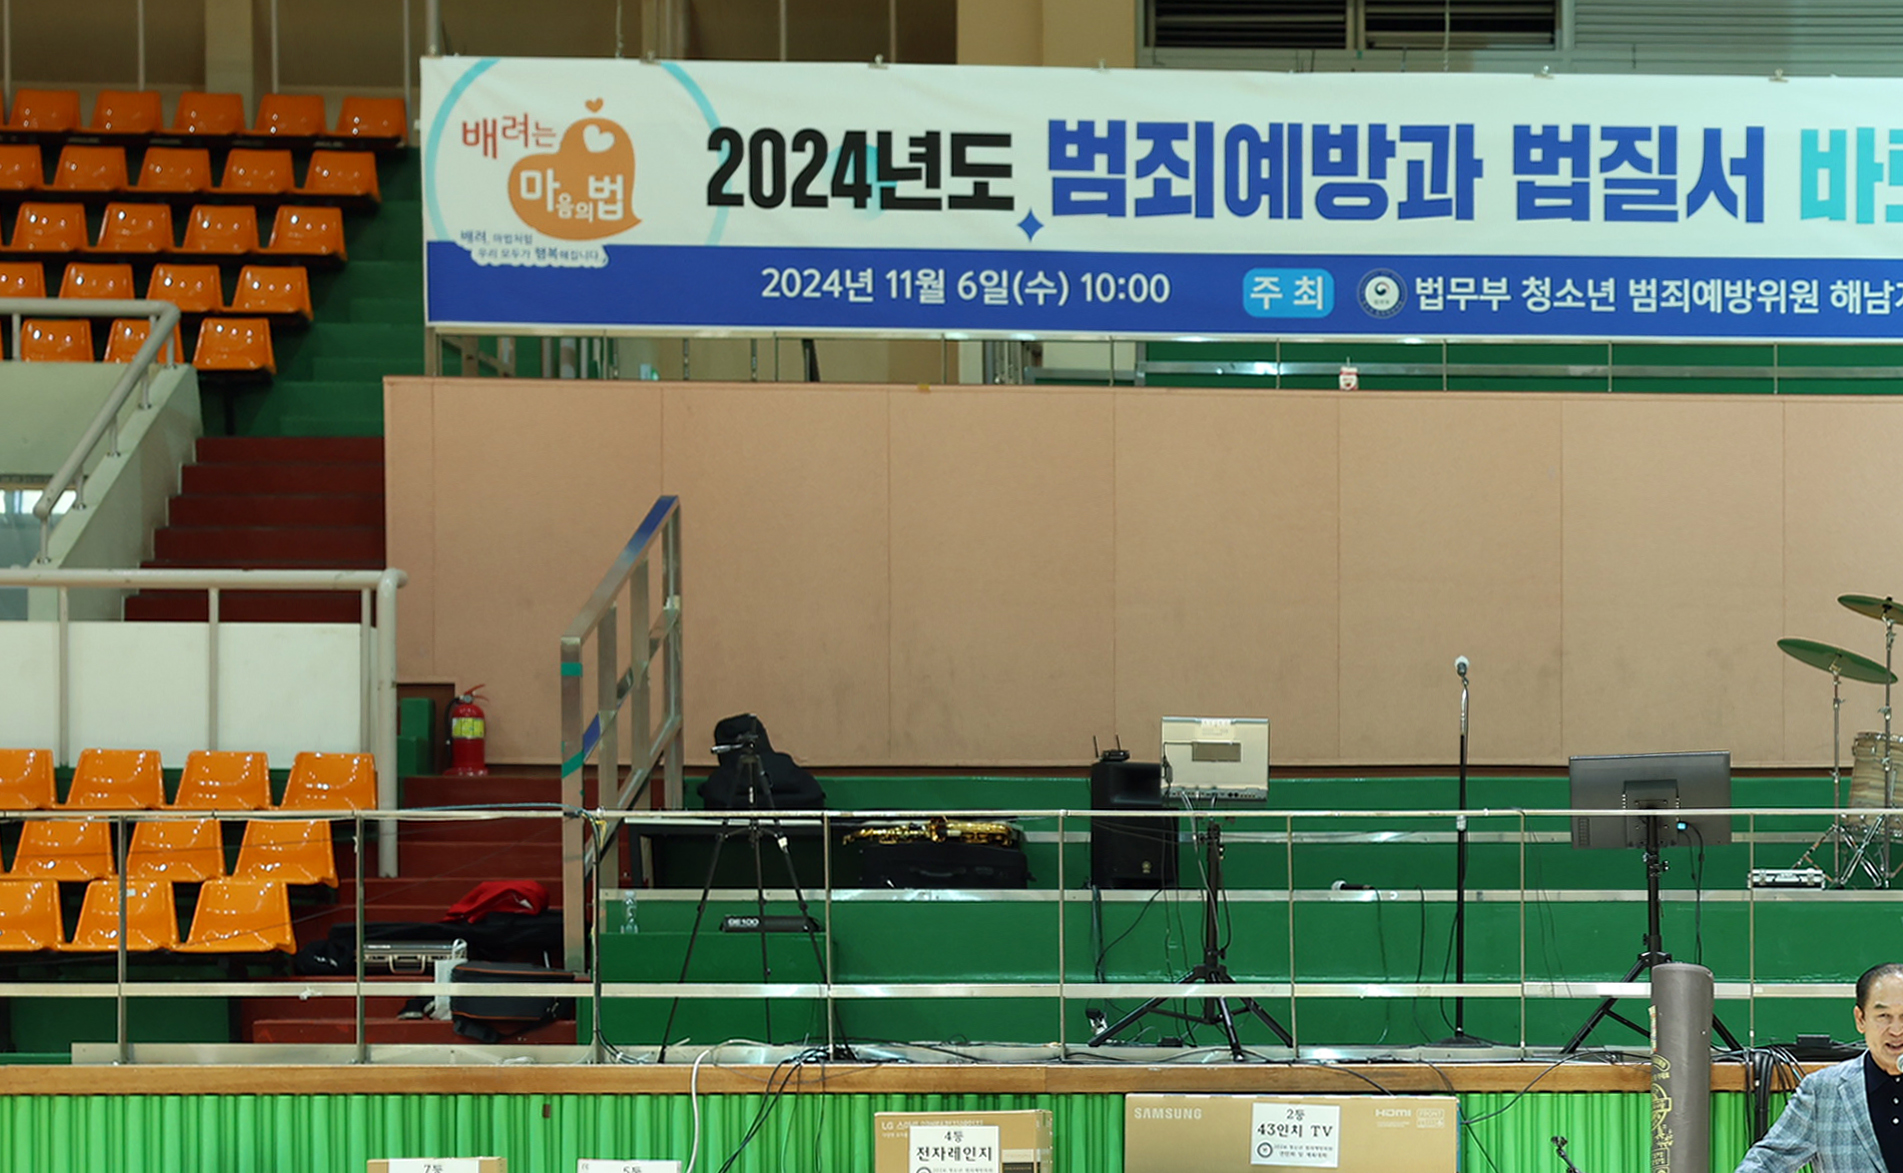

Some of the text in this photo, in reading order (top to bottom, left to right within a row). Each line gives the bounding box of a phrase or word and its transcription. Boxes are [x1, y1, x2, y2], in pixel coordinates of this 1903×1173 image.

[462, 113, 556, 159] 배려는
[706, 126, 1015, 212] 2024년도
[1048, 119, 1483, 221] 범죄예방과
[1513, 123, 1765, 224] 법질서
[761, 267, 1171, 307] 2024년 11월 6일(수) 10:00
[1414, 276, 1511, 312] 법무부
[1521, 276, 1617, 313] 청소년
[1629, 278, 1819, 315] 범죄예방위원
[1133, 1107, 1202, 1120] SAMSUNG
[1287, 1109, 1305, 1121] 2등
[1375, 1109, 1411, 1117] HDMI
[944, 1131, 964, 1143] 4등
[1257, 1123, 1334, 1138] 43인치 TV
[916, 1146, 992, 1162] 전자레인지
